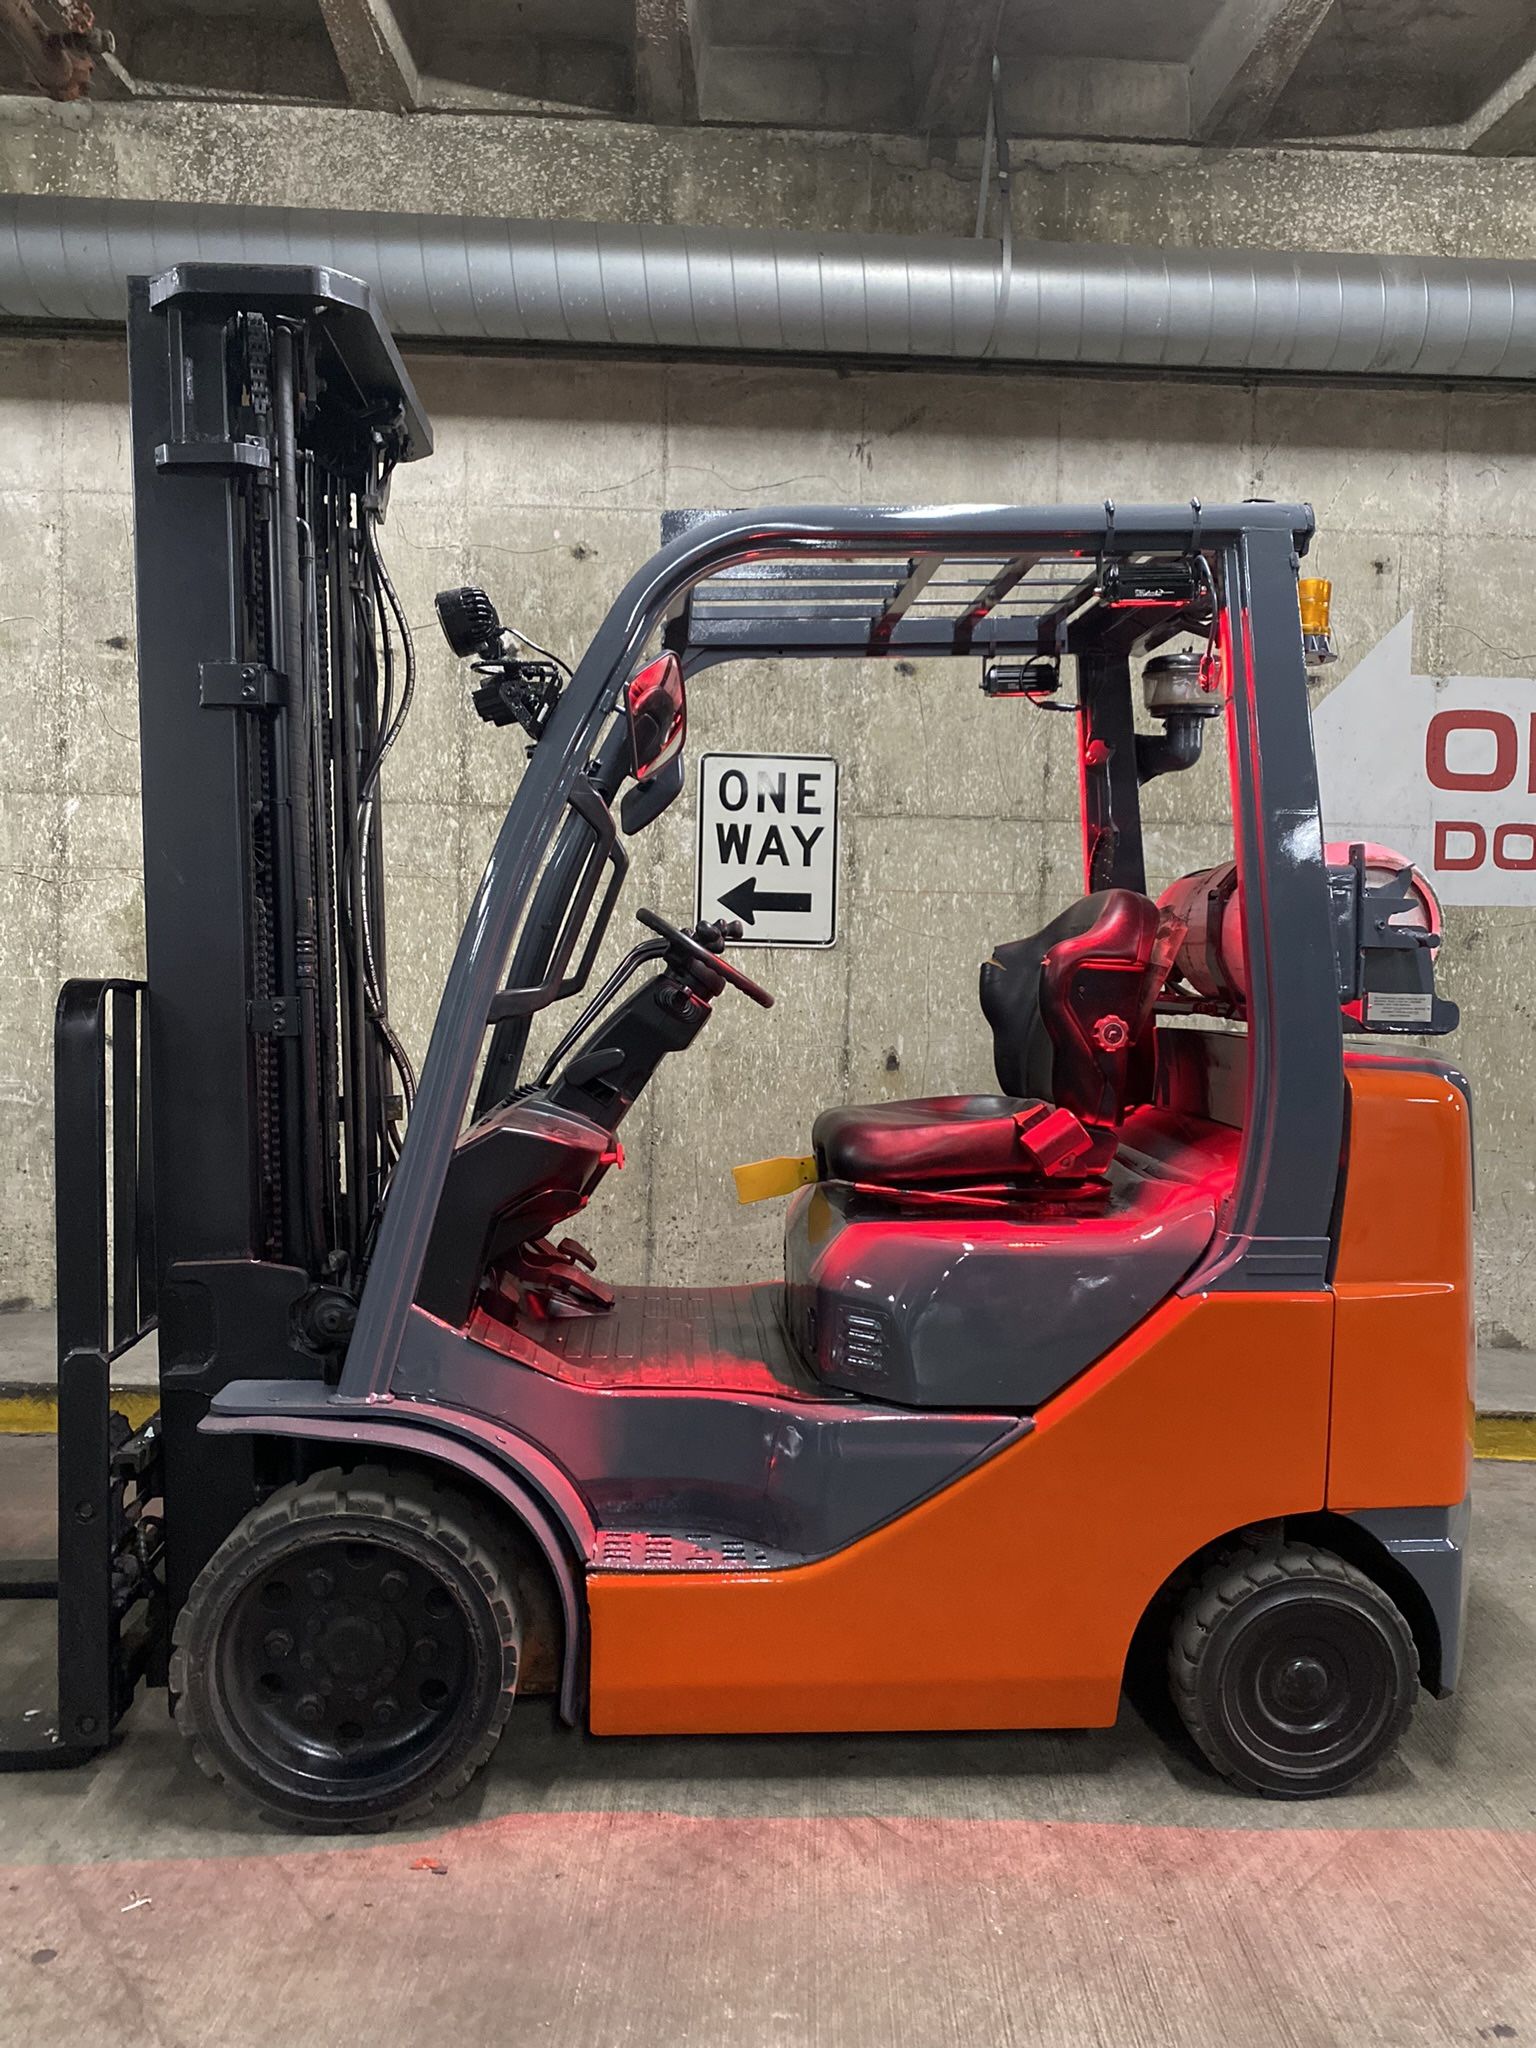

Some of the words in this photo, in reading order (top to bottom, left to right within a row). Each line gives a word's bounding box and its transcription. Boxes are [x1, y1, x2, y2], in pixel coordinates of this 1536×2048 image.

[1426, 709, 1536, 793] O
[719, 769, 822, 814] ONE
[716, 823, 825, 867] WAY
